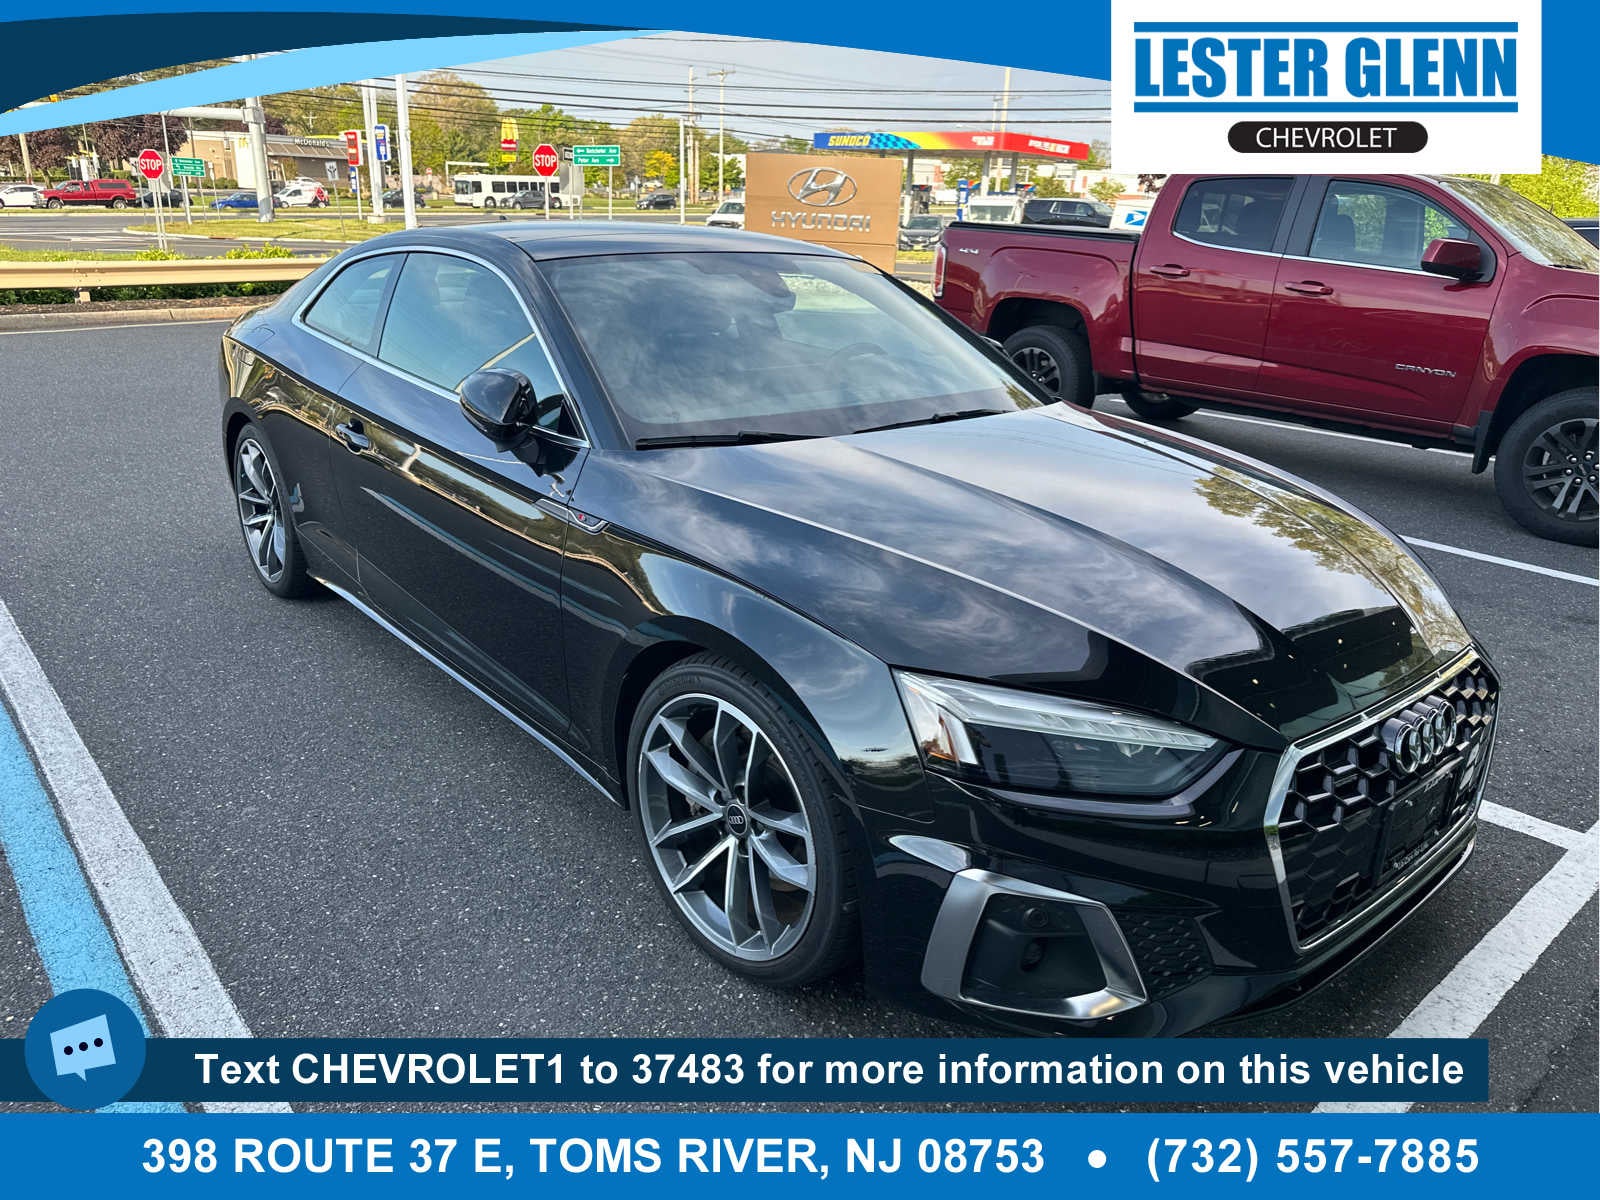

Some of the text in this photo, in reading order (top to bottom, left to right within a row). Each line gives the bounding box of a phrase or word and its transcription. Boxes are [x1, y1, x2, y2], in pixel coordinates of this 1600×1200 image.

[828, 135, 871, 147] SUNOCO
[140, 159, 162, 171] STOP
[534, 155, 557, 168] STOP
[771, 210, 871, 233] HYUNDAI
[1395, 363, 1457, 378] CANYON
